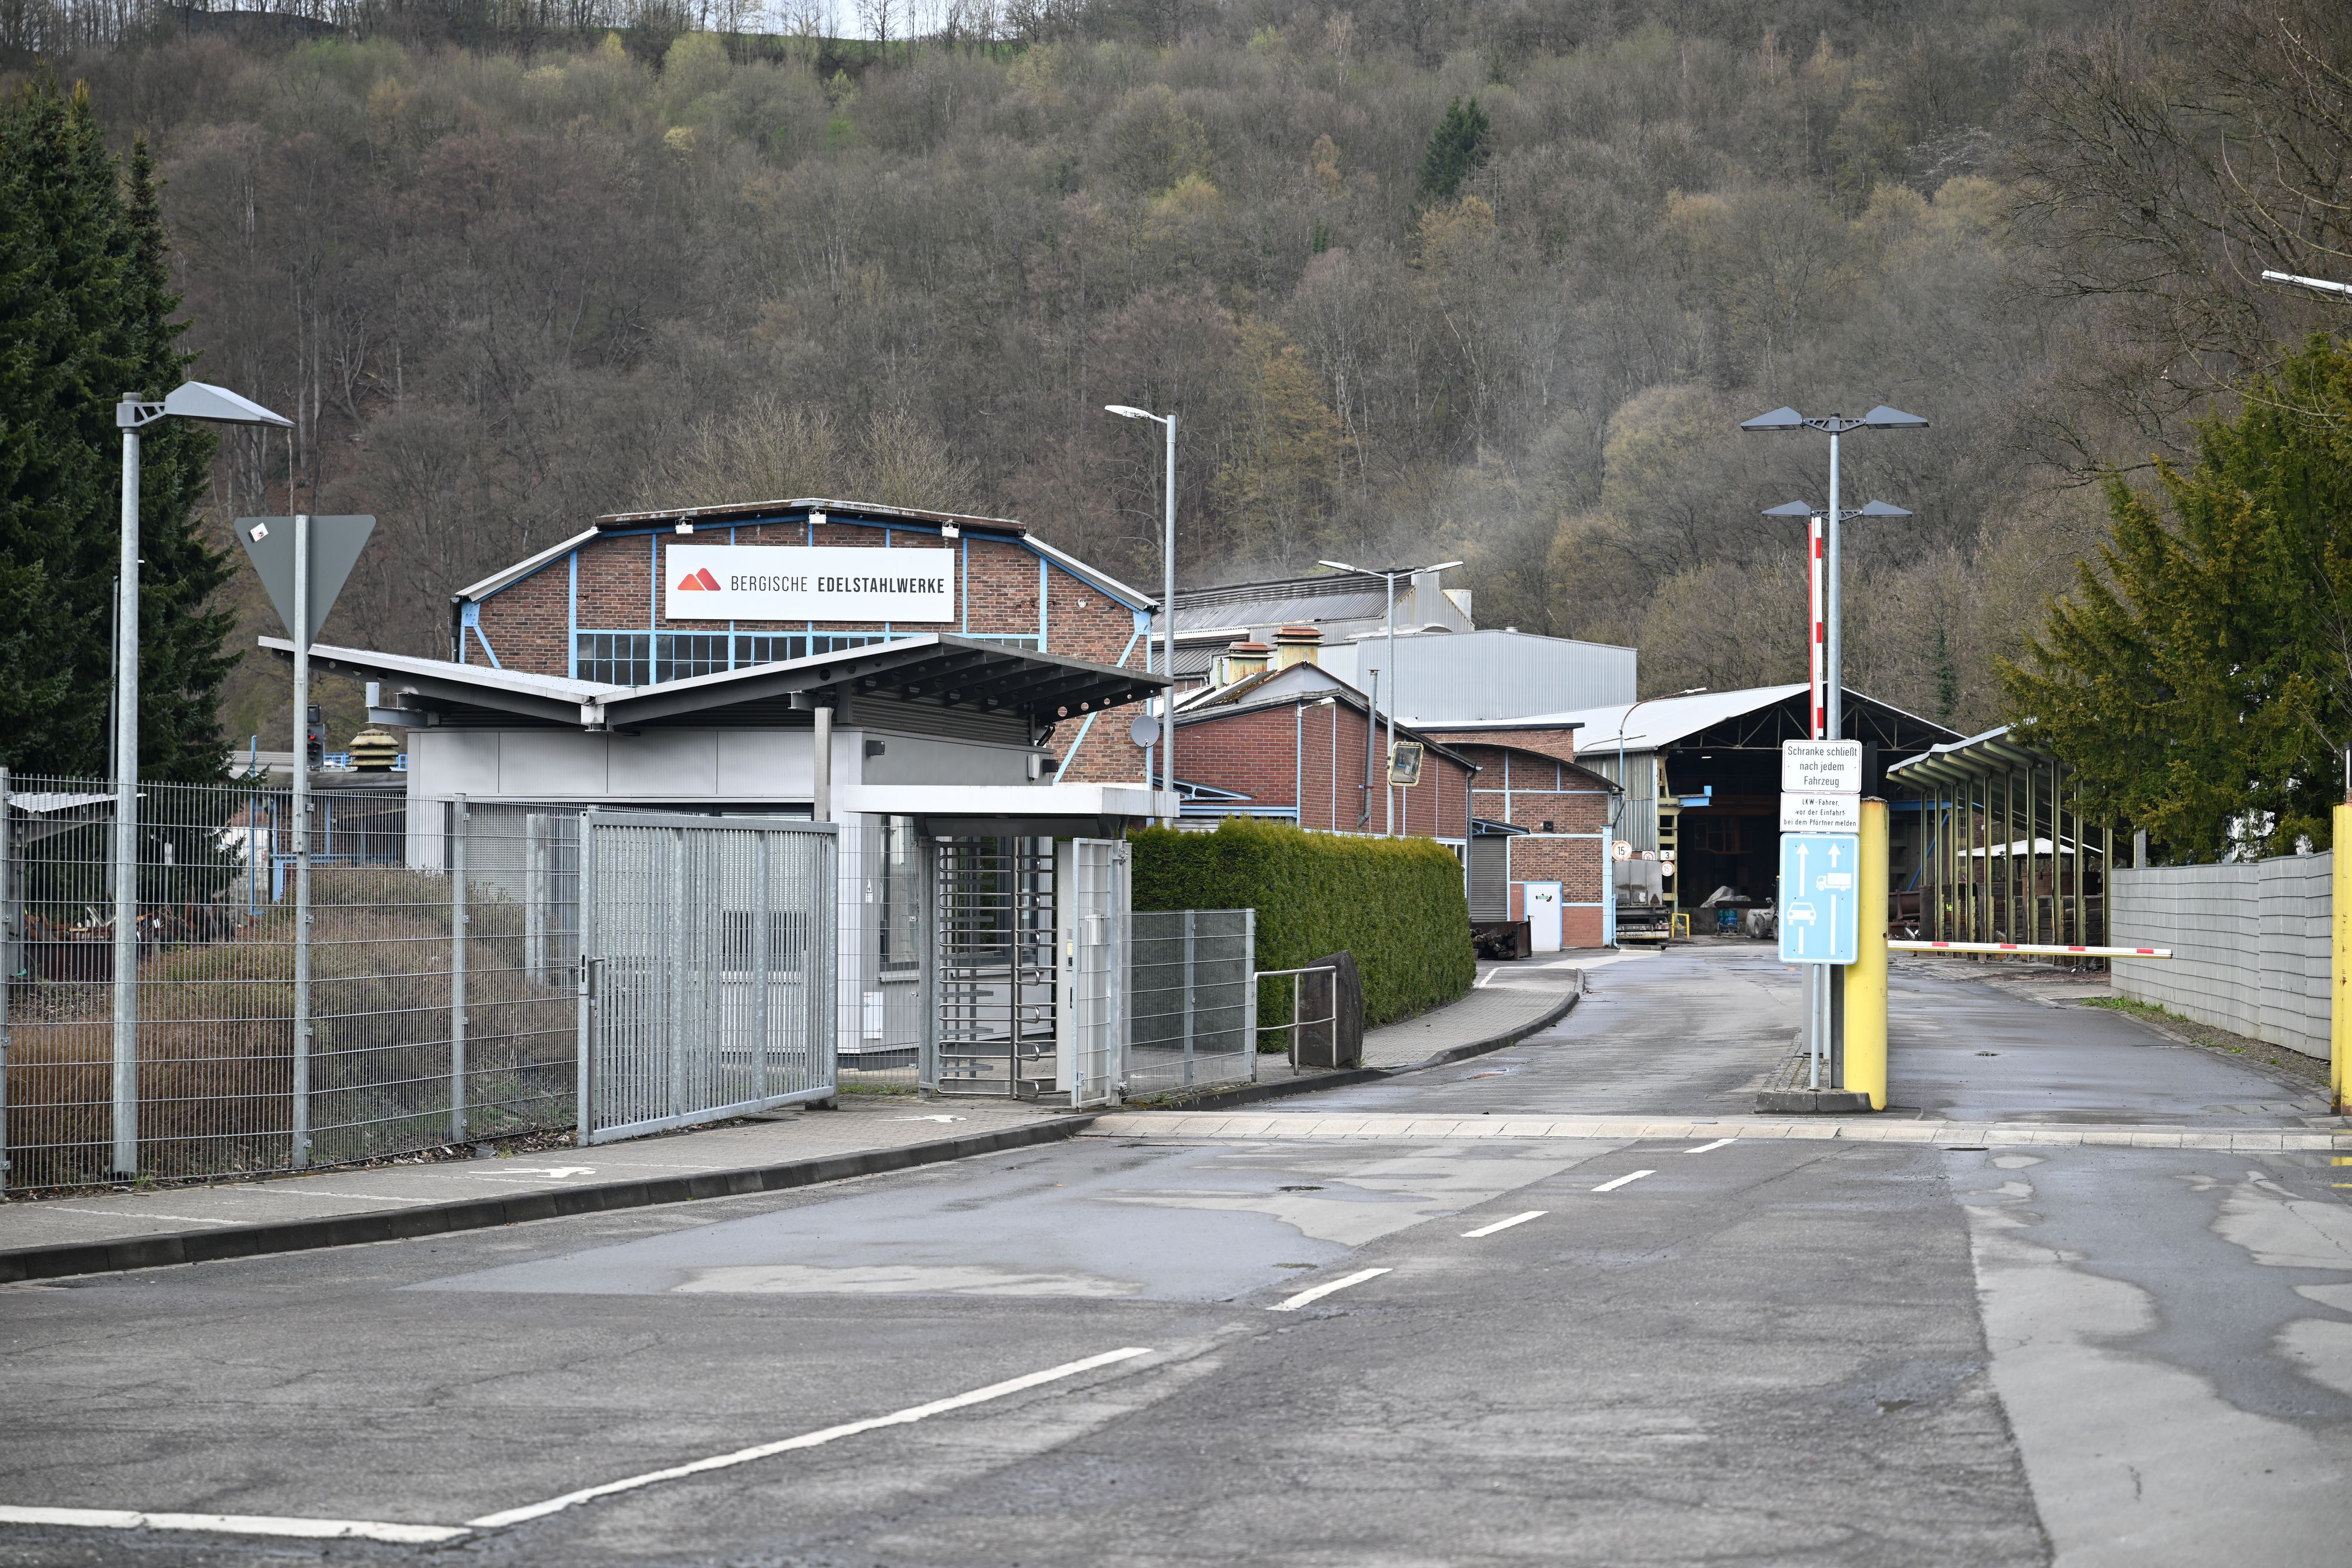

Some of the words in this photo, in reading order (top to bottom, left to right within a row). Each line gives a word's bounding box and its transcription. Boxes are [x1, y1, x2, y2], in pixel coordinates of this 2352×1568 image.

[731, 576, 808, 591] BERGISCHE
[818, 576, 944, 594] EDELSTAHLWERKE
[1788, 746, 1824, 755] Schranke
[1826, 747, 1857, 757] schließt
[1800, 761, 1818, 770] nach
[1820, 762, 1844, 773] jedem
[1804, 776, 1839, 788] Fahrzeug
[1618, 846, 1625, 855] 15
